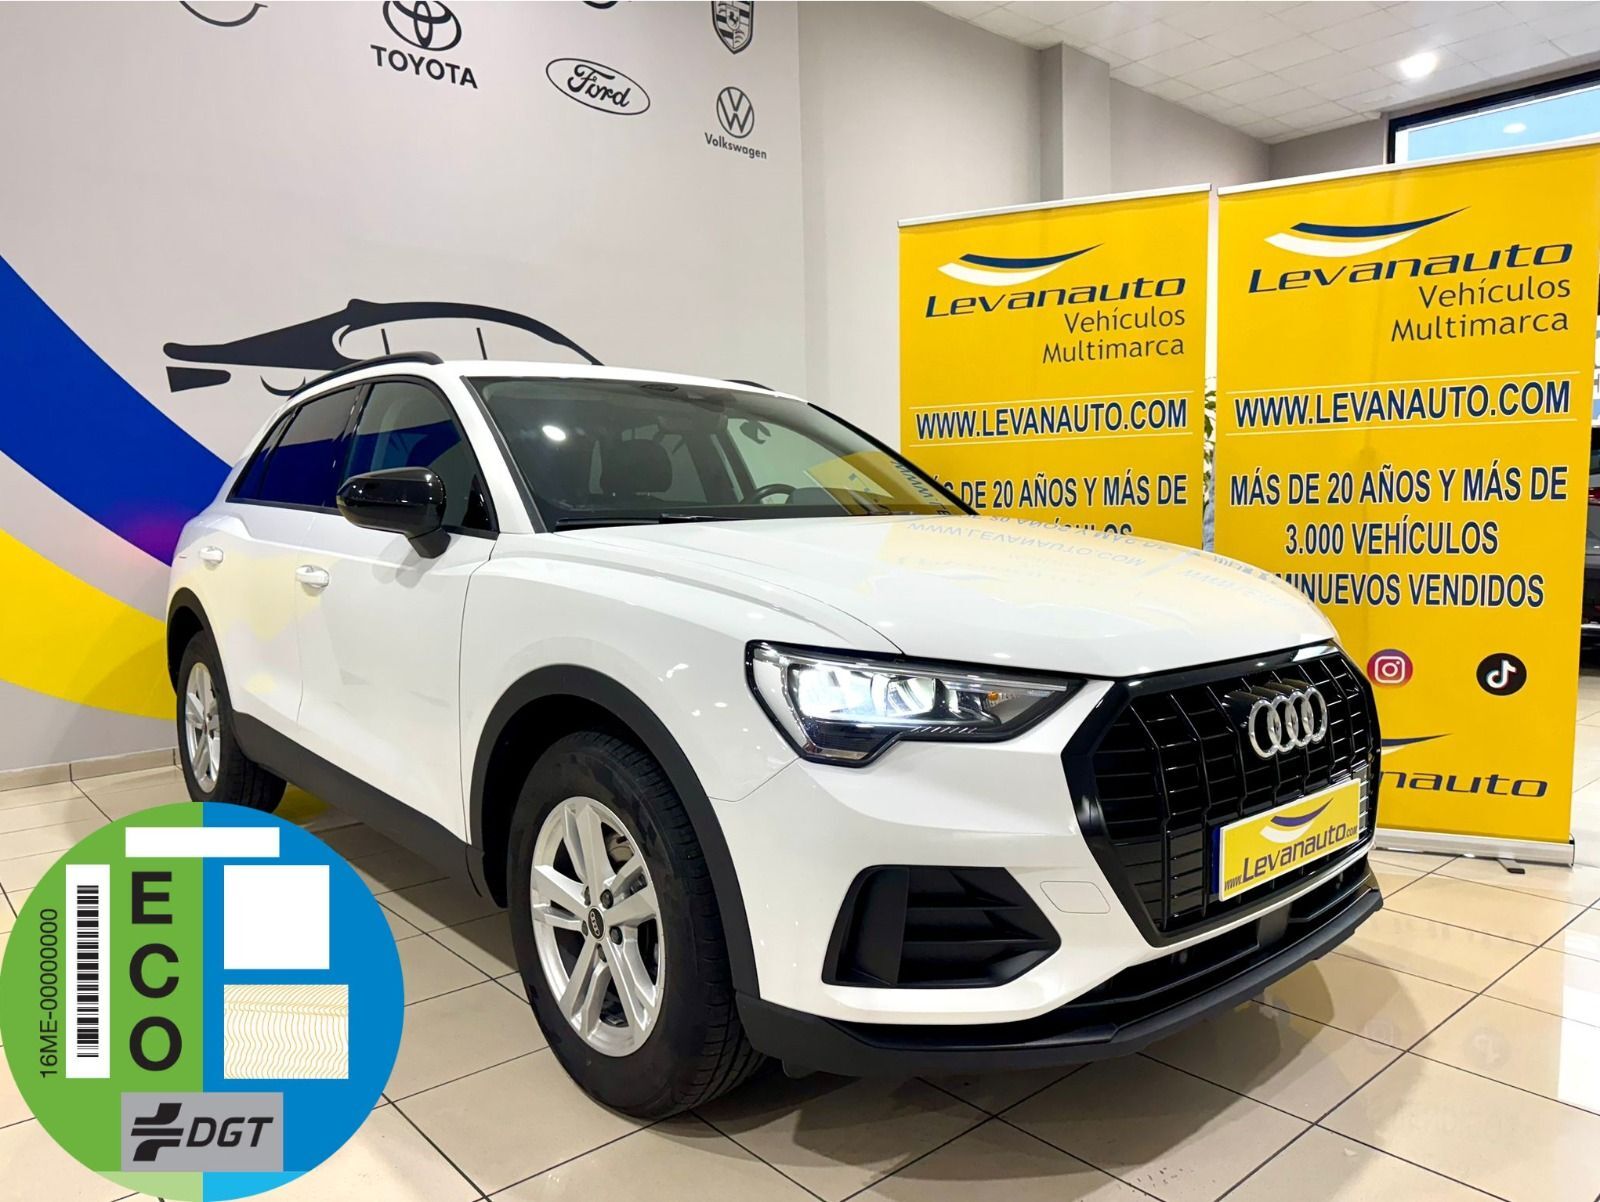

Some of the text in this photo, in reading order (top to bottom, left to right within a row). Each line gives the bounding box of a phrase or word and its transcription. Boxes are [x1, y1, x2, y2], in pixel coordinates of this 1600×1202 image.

[370, 44, 478, 89] TOYOTA
[567, 64, 631, 108] Ford
[704, 132, 767, 159] Volkswagen
[1248, 243, 1573, 294] Levanauto
[925, 277, 1186, 319] Levanauto
[1418, 276, 1571, 309] Vehículos
[1063, 306, 1186, 334] Vehículos
[1390, 311, 1569, 342] Multimarca
[1042, 338, 1185, 364] Multimarca
[915, 398, 1187, 440] WWW.LEVANAUTO.COM
[1234, 380, 1570, 428] WWW.LEVANAUTO.COM
[960, 480, 987, 509] DE
[992, 480, 1014, 509] 20
[1018, 472, 1077, 508] AÑOS
[1083, 477, 1098, 507] Y
[1103, 468, 1150, 506] MÁS
[1157, 474, 1188, 505] DE
[1230, 460, 1568, 506] MÁS DE 20 AÑOS Y MÁS DE
[1285, 514, 1499, 556] 3.000 VEHÍCULOS
[1408, 573, 1545, 608] VENDIDOS
